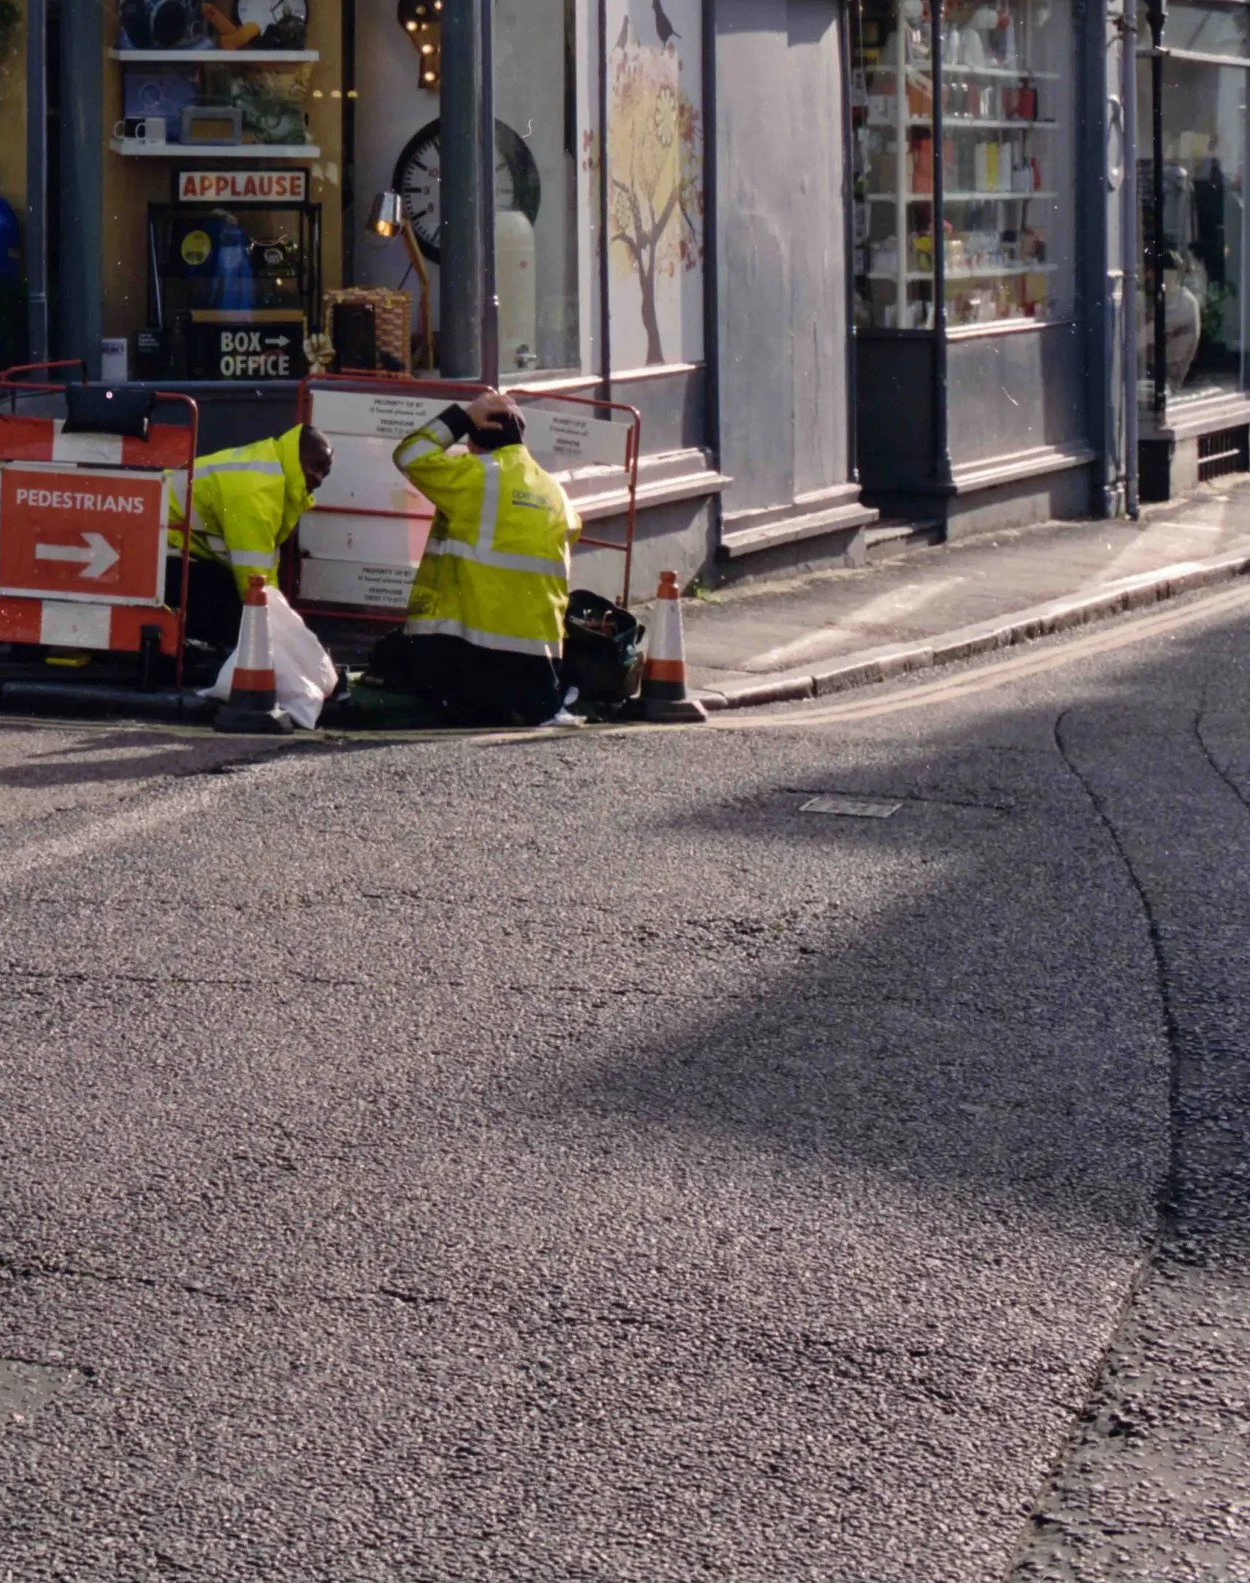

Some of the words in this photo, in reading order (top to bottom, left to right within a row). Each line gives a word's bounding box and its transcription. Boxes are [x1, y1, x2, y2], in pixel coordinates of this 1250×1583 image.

[182, 175, 303, 197] APPLAUSE
[220, 332, 261, 353] BOX
[220, 355, 290, 376] OFFICE
[16, 488, 144, 514] PEDESTRIANS
